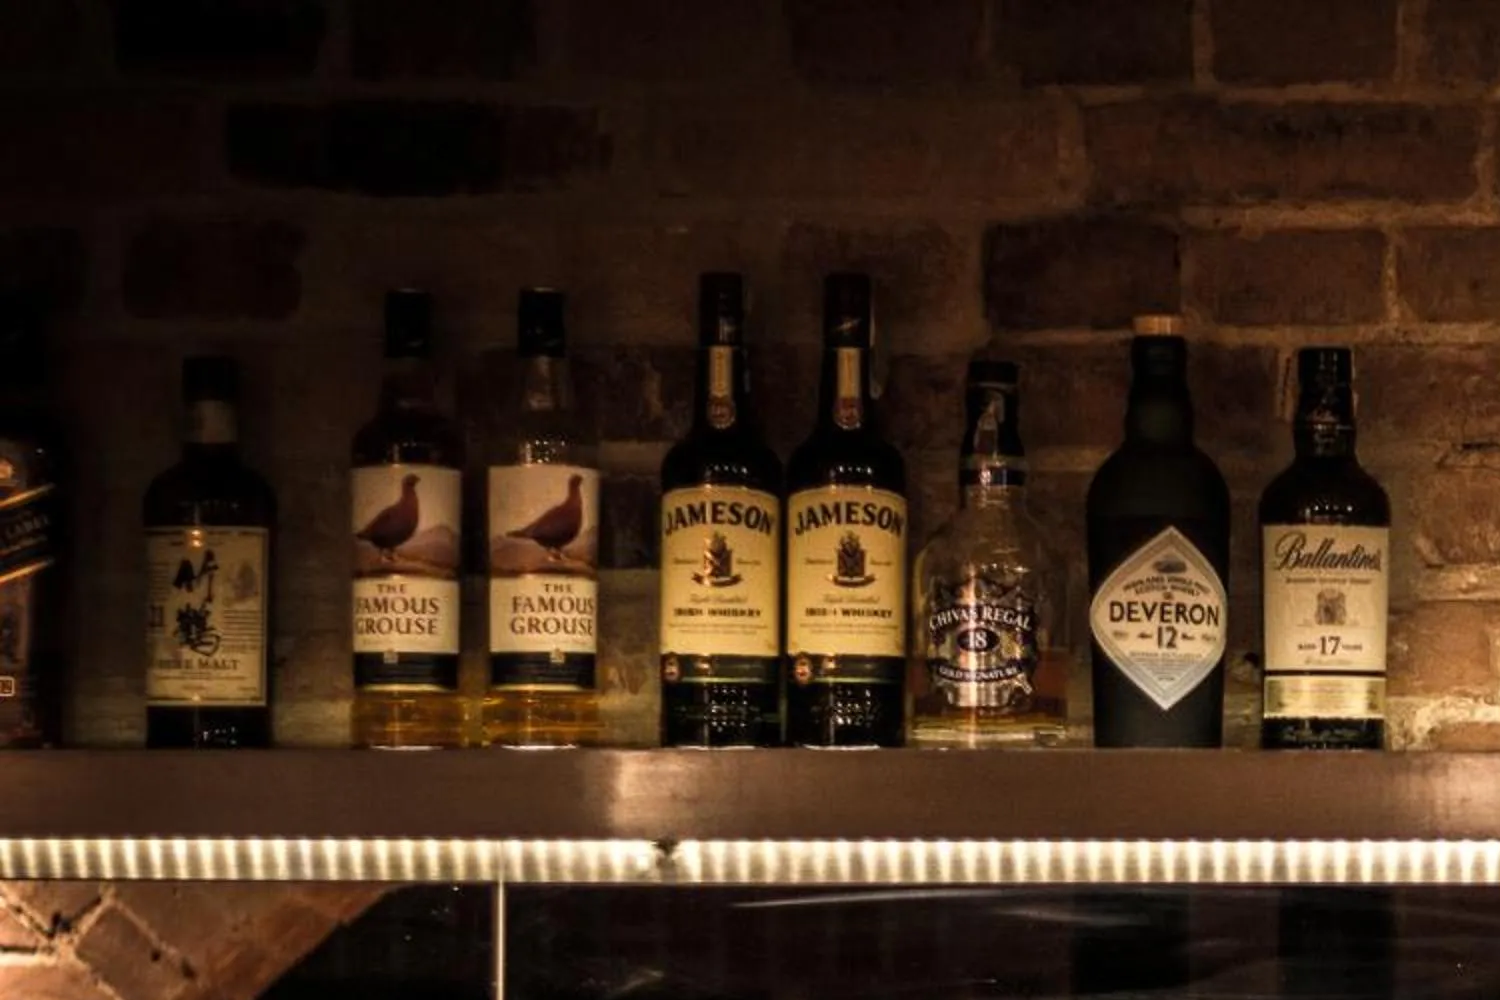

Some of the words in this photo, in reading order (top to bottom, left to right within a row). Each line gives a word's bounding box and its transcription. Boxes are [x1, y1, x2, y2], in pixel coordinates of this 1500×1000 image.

[663, 501, 776, 537] JAMESON
[794, 501, 904, 537] JAMESON
[377, 583, 408, 594] THE
[544, 583, 575, 594] THE
[354, 596, 441, 615] FAMOUS
[511, 596, 596, 615] FAMOUS
[1108, 601, 1220, 627] DEVERON
[356, 618, 438, 636] GROUSE
[510, 617, 595, 637] GROUSE
[929, 606, 978, 630] CHIVAS
[982, 605, 1032, 630] REGAL
[968, 631, 988, 649] 18
[1157, 626, 1179, 649] 12
[1319, 636, 1341, 656] 17
